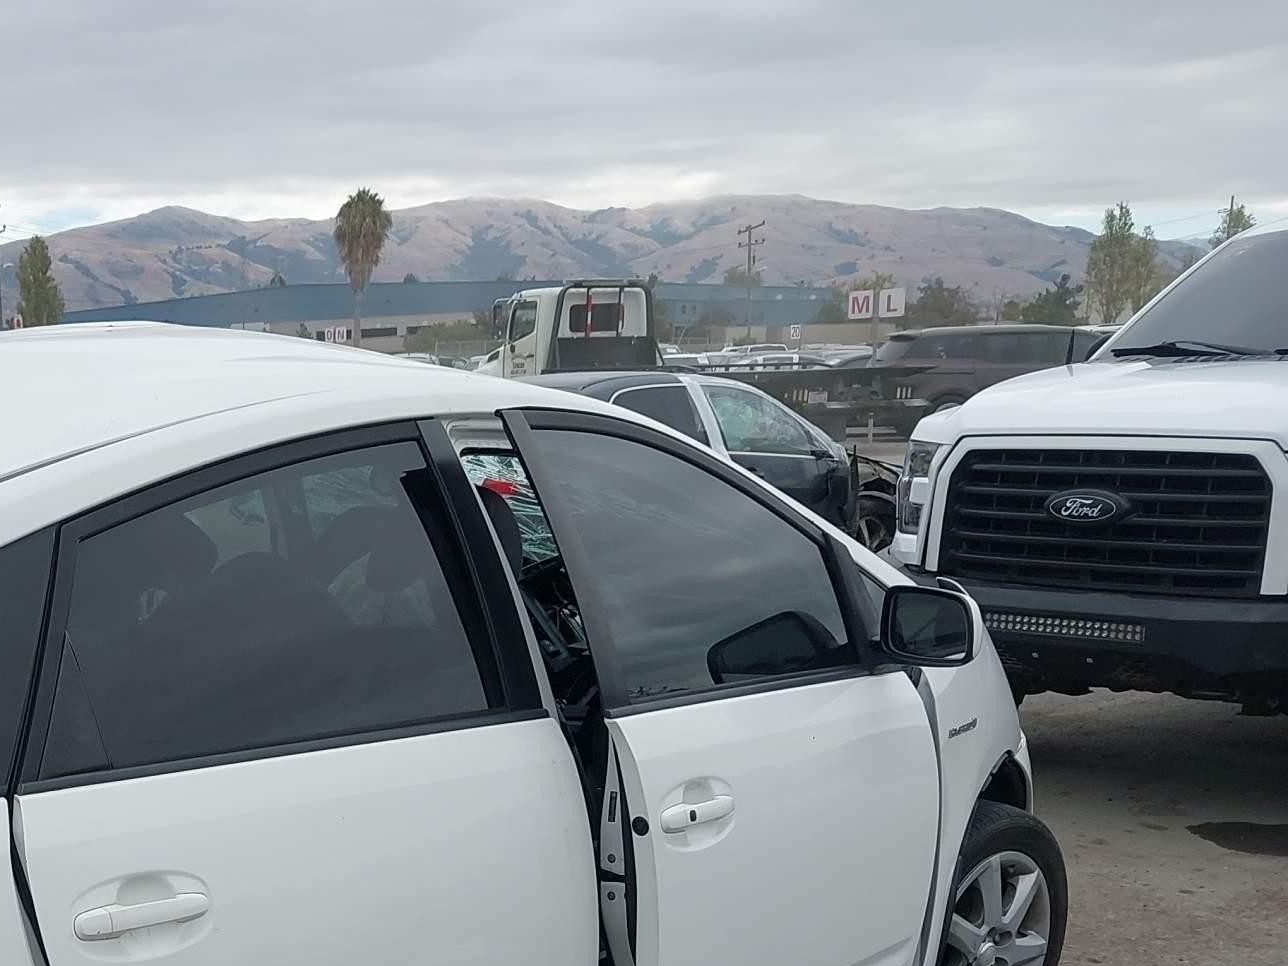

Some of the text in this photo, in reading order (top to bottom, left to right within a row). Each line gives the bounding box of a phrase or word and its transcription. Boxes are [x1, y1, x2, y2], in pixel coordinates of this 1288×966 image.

[851, 294, 898, 314] M L
[337, 330, 344, 340] N
[791, 326, 800, 338] 20
[1061, 498, 1103, 516] Ford
